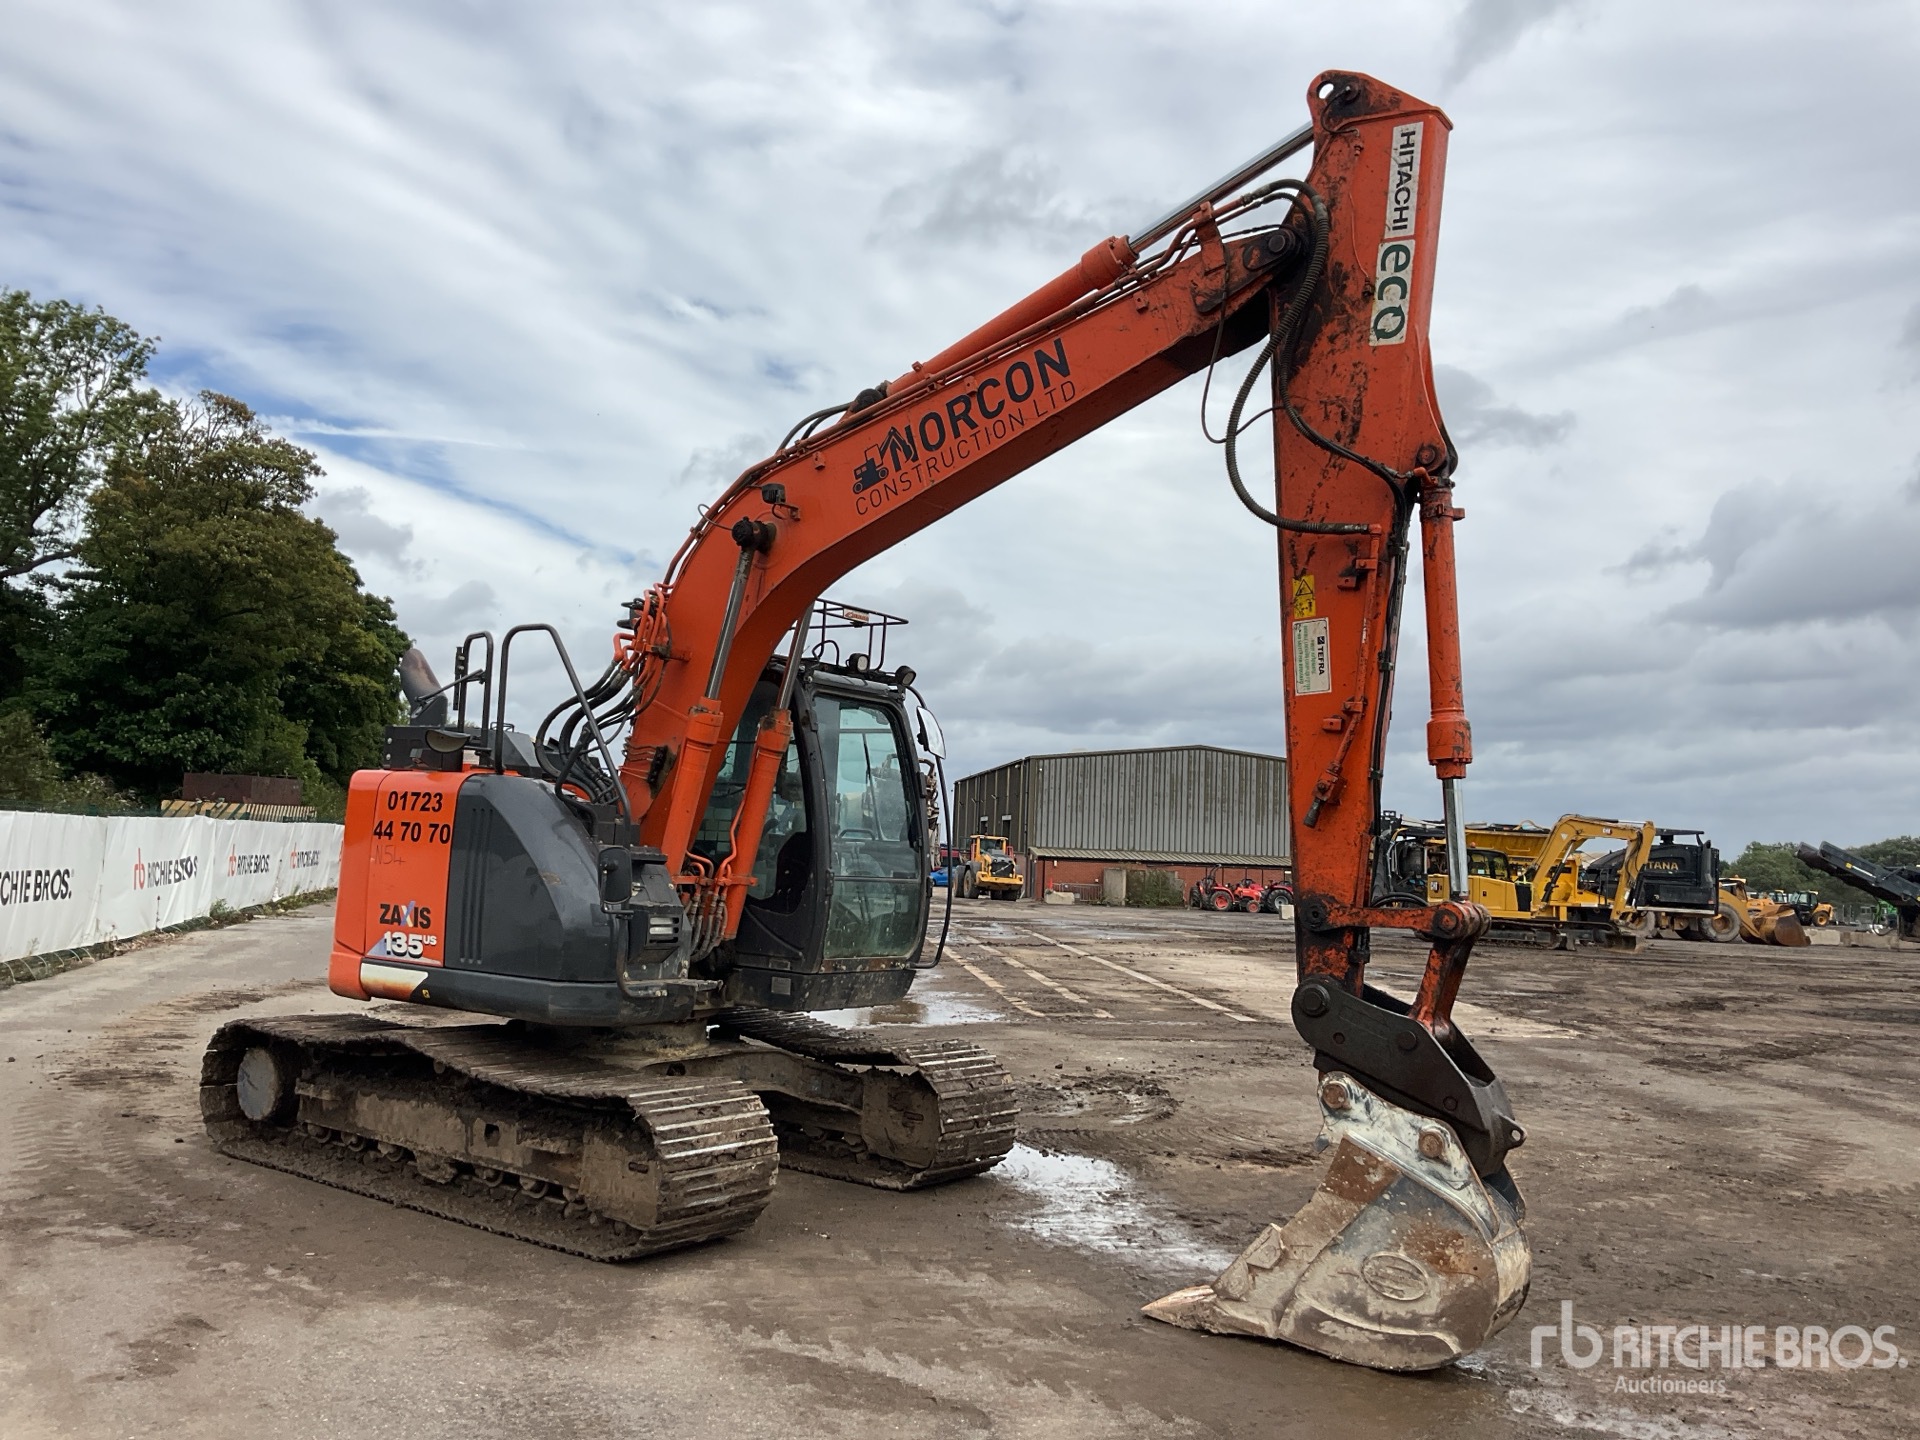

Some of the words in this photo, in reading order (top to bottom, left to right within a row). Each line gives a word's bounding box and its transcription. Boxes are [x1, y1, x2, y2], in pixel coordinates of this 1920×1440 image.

[1392, 130, 1416, 231] HITACHI
[1373, 244, 1411, 341] eco
[889, 337, 1071, 472] NORCON
[856, 408, 1025, 516] CONSTRUCTION
[1034, 380, 1076, 418] LTD
[388, 790, 443, 812] 01723
[373, 820, 393, 840] 44
[401, 821, 421, 842] 70
[429, 823, 451, 844] 70
[1648, 861, 1679, 870] TANA
[0, 870, 31, 906] CHIE
[33, 868, 72, 902] BROS.
[379, 900, 431, 929] ZAXIS
